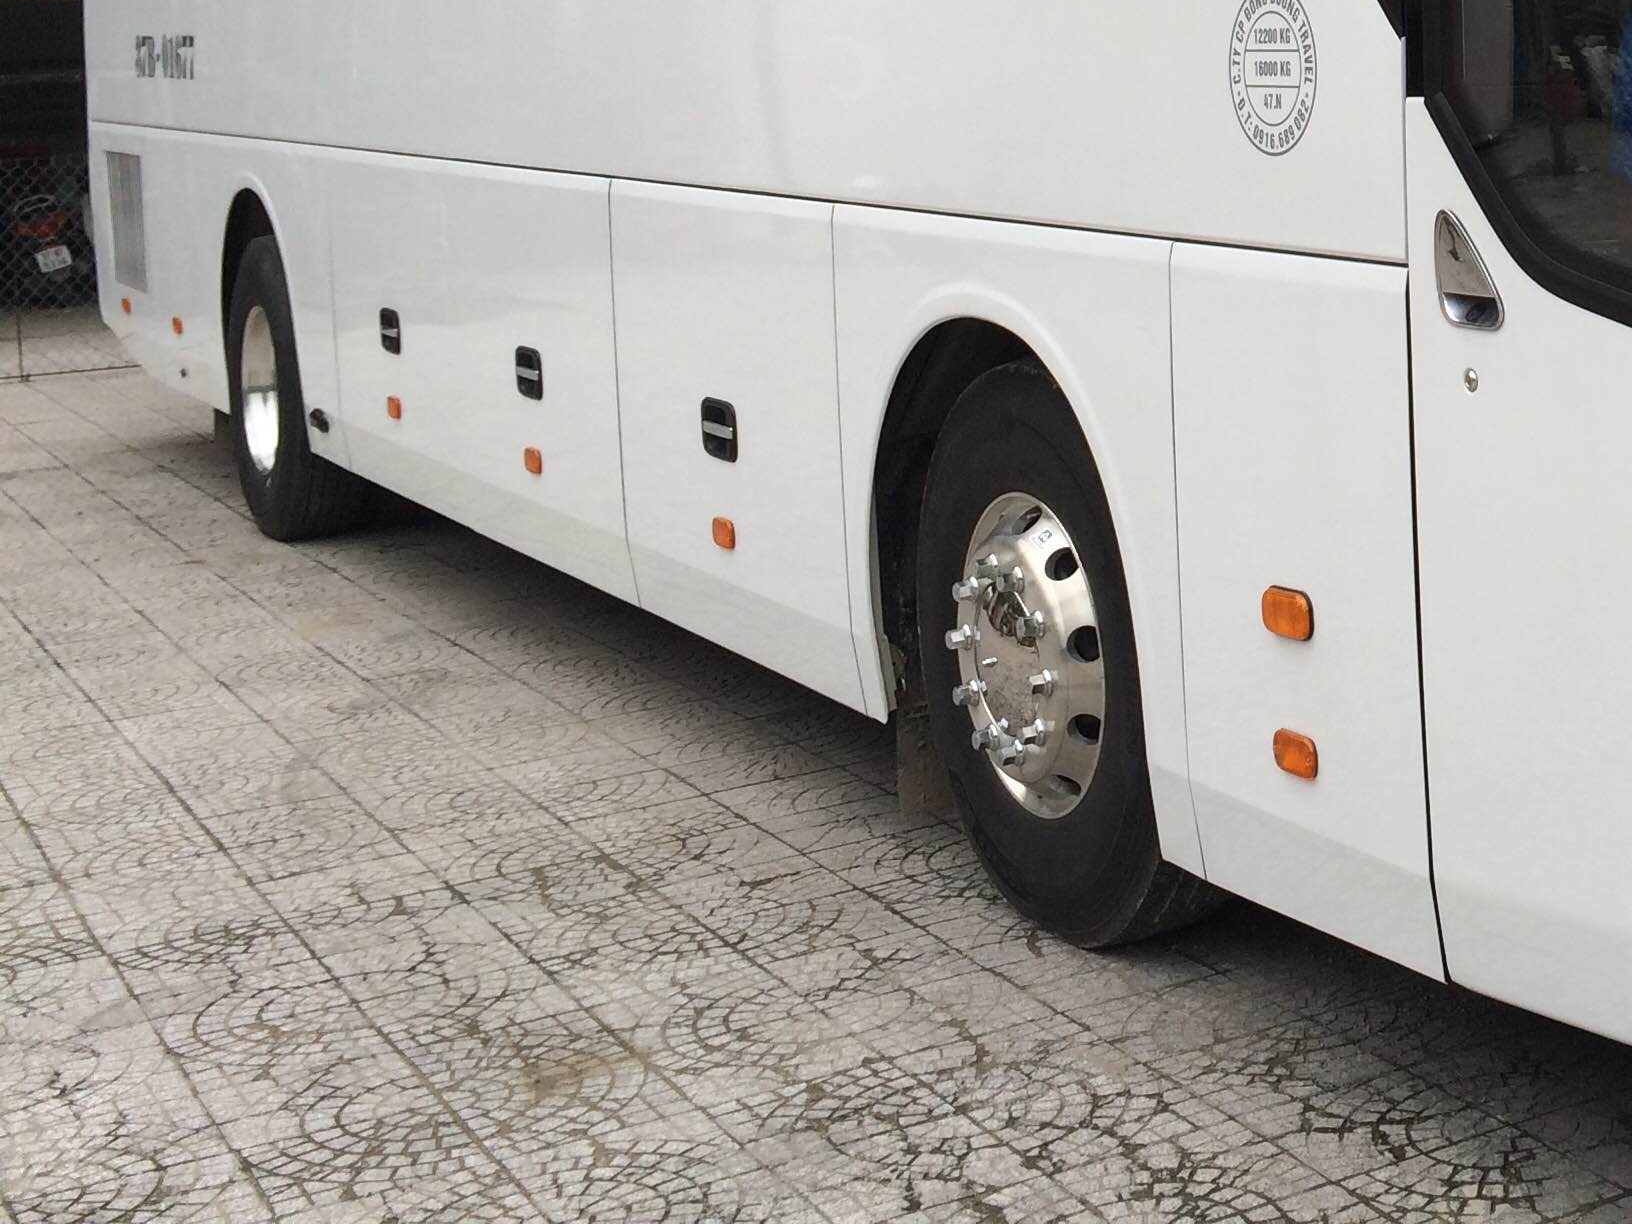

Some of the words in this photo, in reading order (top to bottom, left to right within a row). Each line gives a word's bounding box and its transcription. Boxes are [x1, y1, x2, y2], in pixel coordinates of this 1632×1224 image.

[1254, 28, 1277, 44] 12200
[1280, 28, 1291, 44] KG
[1236, 20, 1245, 44] CP
[1298, 19, 1314, 85] TRAVEL
[1255, 61, 1278, 76] 16000
[1280, 61, 1291, 76] KG
